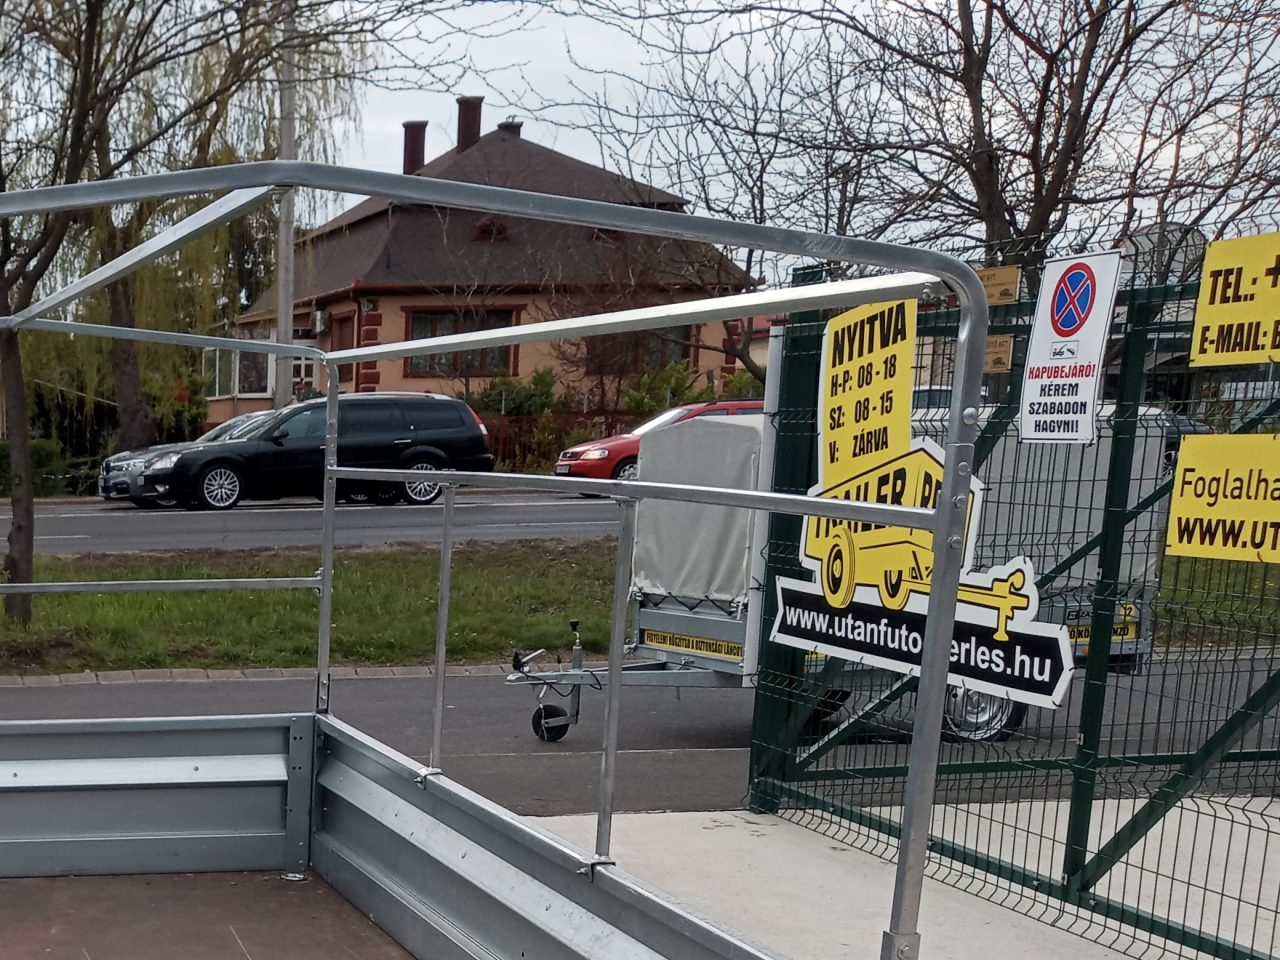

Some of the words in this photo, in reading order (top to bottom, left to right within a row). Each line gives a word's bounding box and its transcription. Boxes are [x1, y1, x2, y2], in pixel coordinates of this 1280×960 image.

[1208, 266, 1258, 306] TEL.:
[831, 301, 907, 368] NYITVA
[1198, 321, 1268, 355] E-MAIL:
[830, 369, 853, 398] H-P:
[857, 362, 874, 389] 08
[883, 353, 897, 380] 18
[1027, 361, 1096, 380] KAPUBEJÁRÓ!
[1039, 381, 1079, 398] KÉREM
[829, 405, 846, 431] SZ:
[854, 397, 870, 424] 08
[879, 389, 894, 416] 15
[1028, 401, 1088, 416] SZABADON
[1033, 419, 1080, 434] HAGYNI!
[829, 440, 839, 464] V:
[852, 426, 889, 458] ZÁRVA
[785, 604, 1052, 683] www.utanfutoerles.hu
